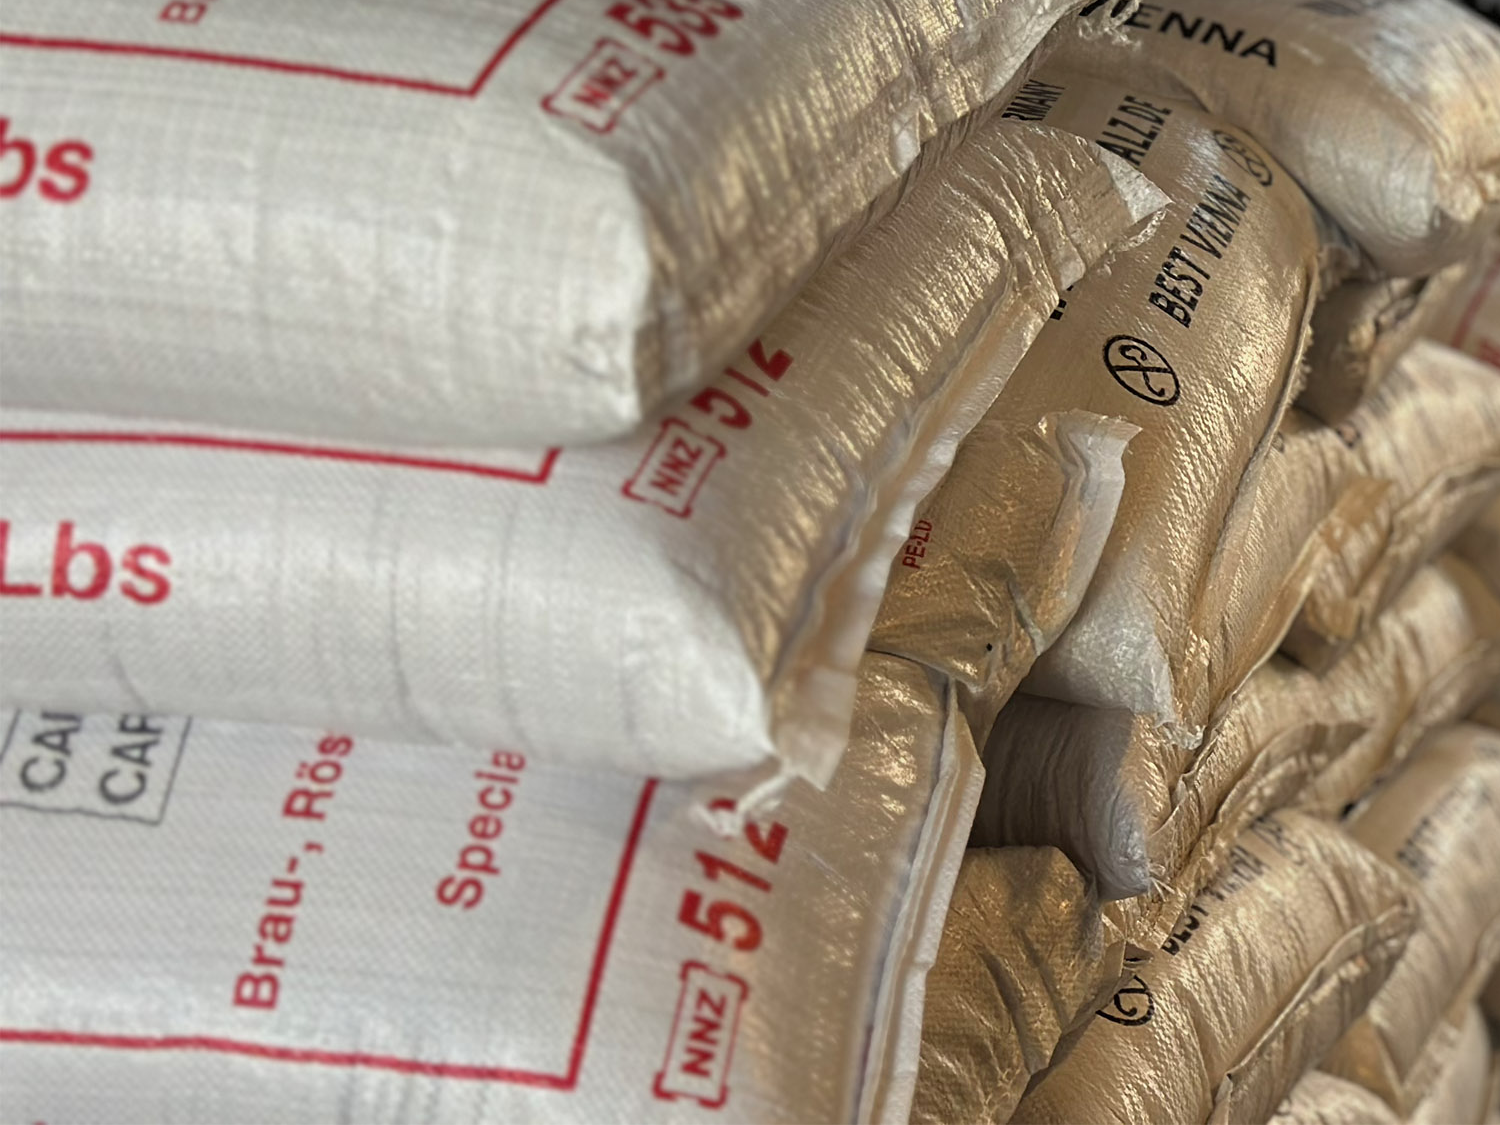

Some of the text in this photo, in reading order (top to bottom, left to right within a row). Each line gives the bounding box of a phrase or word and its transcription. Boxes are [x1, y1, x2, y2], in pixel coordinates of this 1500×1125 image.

[1002, 79, 1066, 121] RMANY
[1094, 95, 1173, 167] ALZ.DE
[0, 115, 95, 205] bs
[1148, 175, 1252, 328] BEST VIENNA
[649, 435, 705, 498] NNZ
[0, 519, 173, 607] Lbs
[281, 726, 355, 822] Rös
[434, 748, 527, 911] Specia
[675, 798, 790, 1079] NNZ 512
